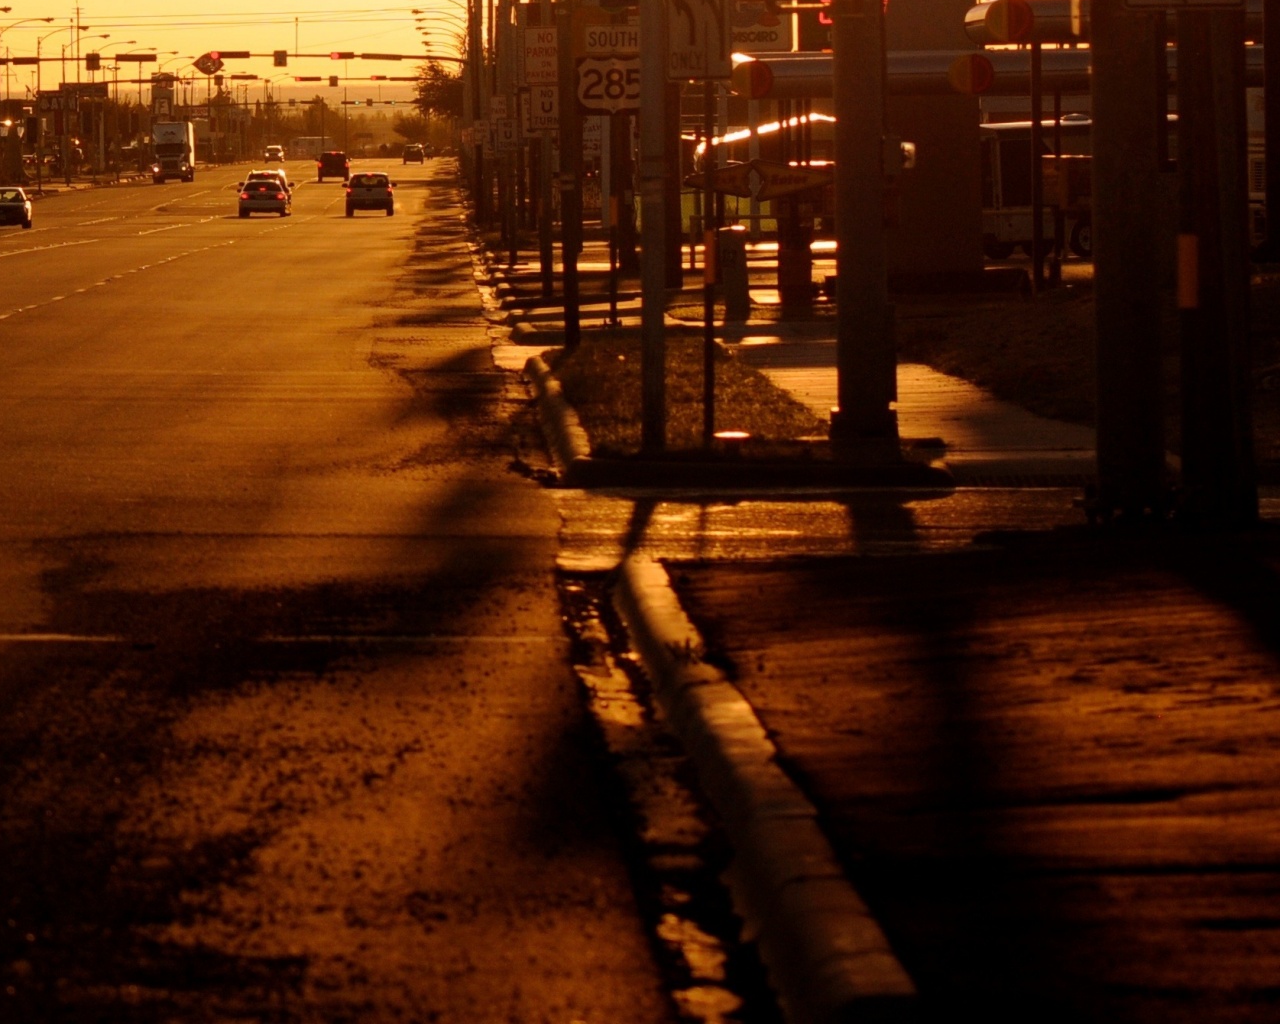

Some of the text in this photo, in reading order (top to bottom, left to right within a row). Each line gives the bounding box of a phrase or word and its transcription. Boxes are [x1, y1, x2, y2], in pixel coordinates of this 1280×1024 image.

[537, 32, 554, 44] NO
[587, 31, 638, 48] SOUTH
[526, 46, 558, 58] PARKIN
[671, 51, 703, 71] ONLY
[582, 68, 640, 100] 285
[540, 89, 554, 98] NO
[541, 101, 553, 113] U
